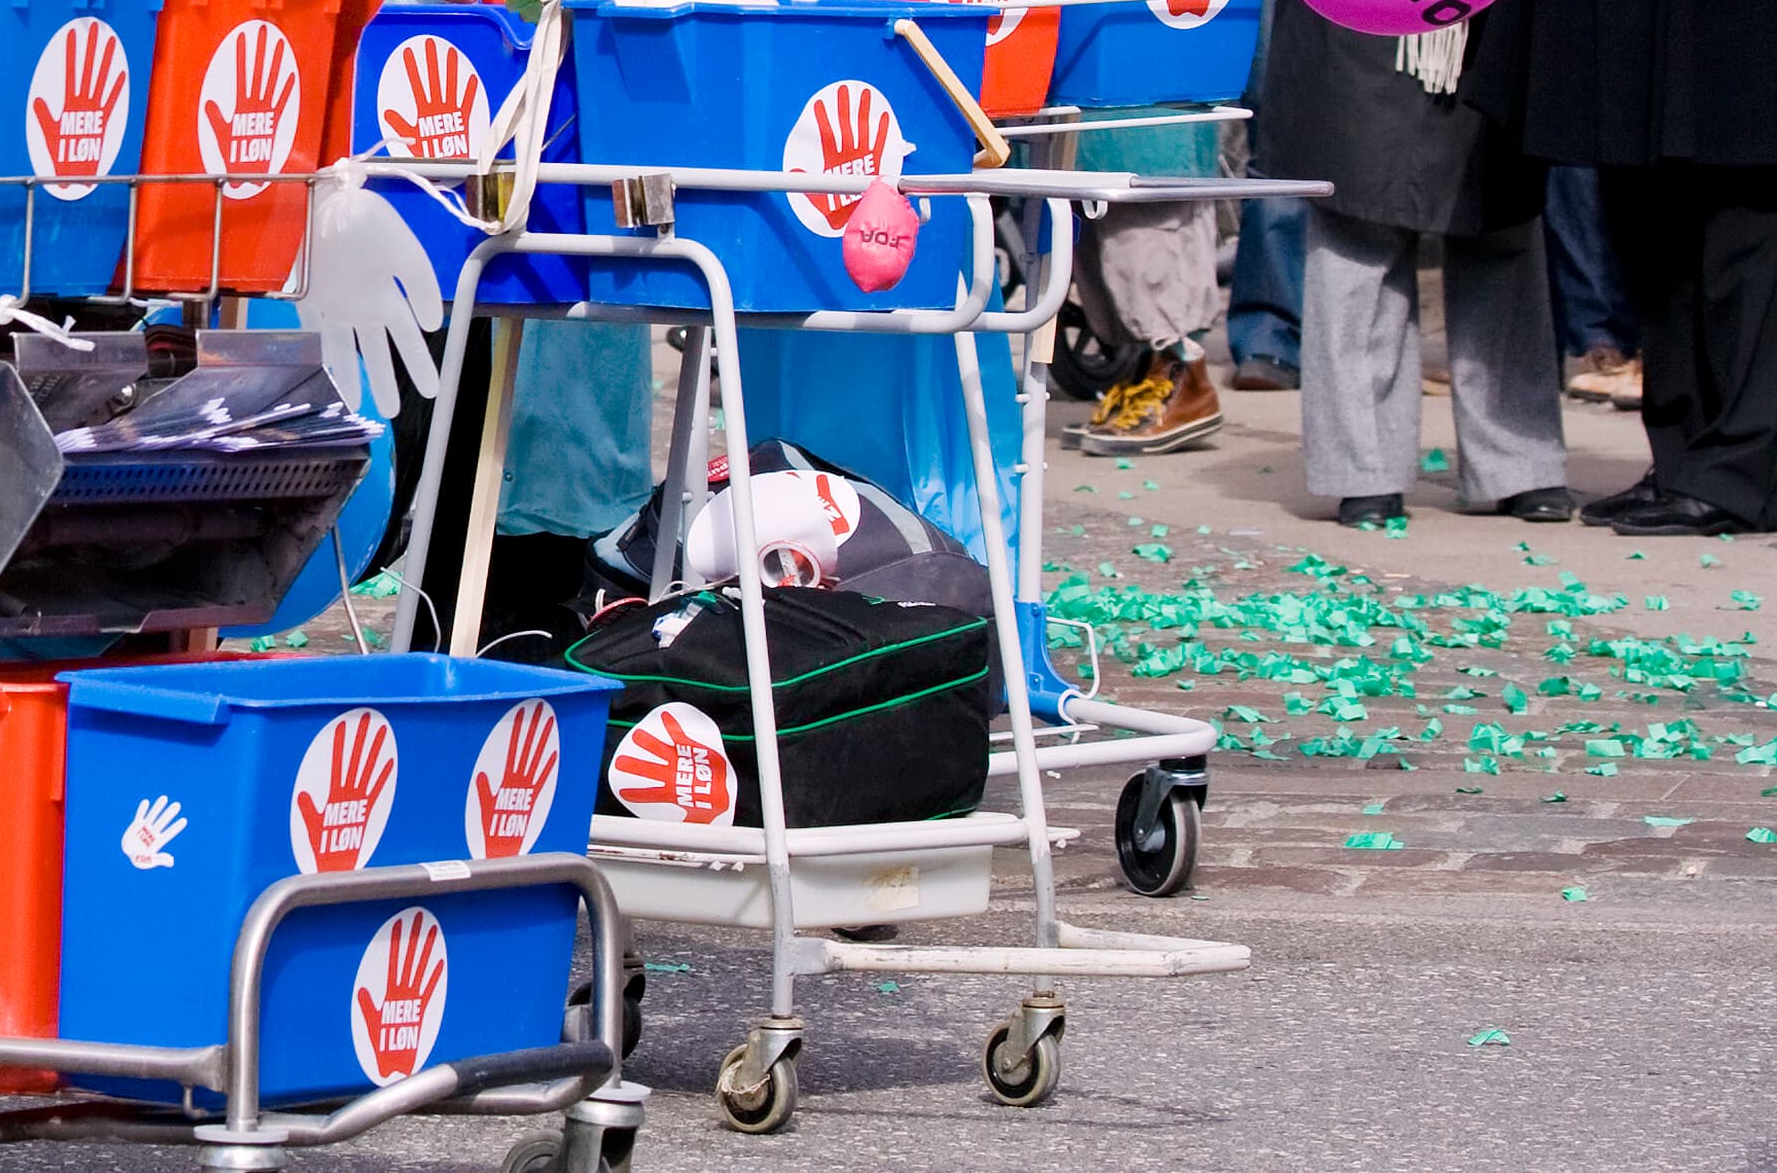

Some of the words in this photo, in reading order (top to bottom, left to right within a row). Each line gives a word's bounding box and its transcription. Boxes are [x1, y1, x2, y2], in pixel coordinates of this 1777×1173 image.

[60, 111, 104, 136] MERE
[232, 112, 275, 137] MERE
[418, 111, 464, 137] MERE
[58, 138, 67, 162] I
[69, 138, 101, 163] LØN
[230, 140, 237, 164] I
[240, 138, 272, 163] LØN
[422, 140, 430, 158] I
[433, 134, 468, 159] LØN
[675, 743, 694, 807] MERE
[693, 746, 712, 795] LØN
[494, 787, 534, 812] MERE
[695, 800, 712, 809] I
[323, 799, 367, 827] MERE
[490, 814, 498, 836] I
[501, 813, 528, 837] LØN
[320, 830, 328, 854] I
[330, 826, 364, 853] LØN
[381, 998, 422, 1024] MERE
[379, 1027, 387, 1052] I
[388, 1025, 419, 1051] LØN
